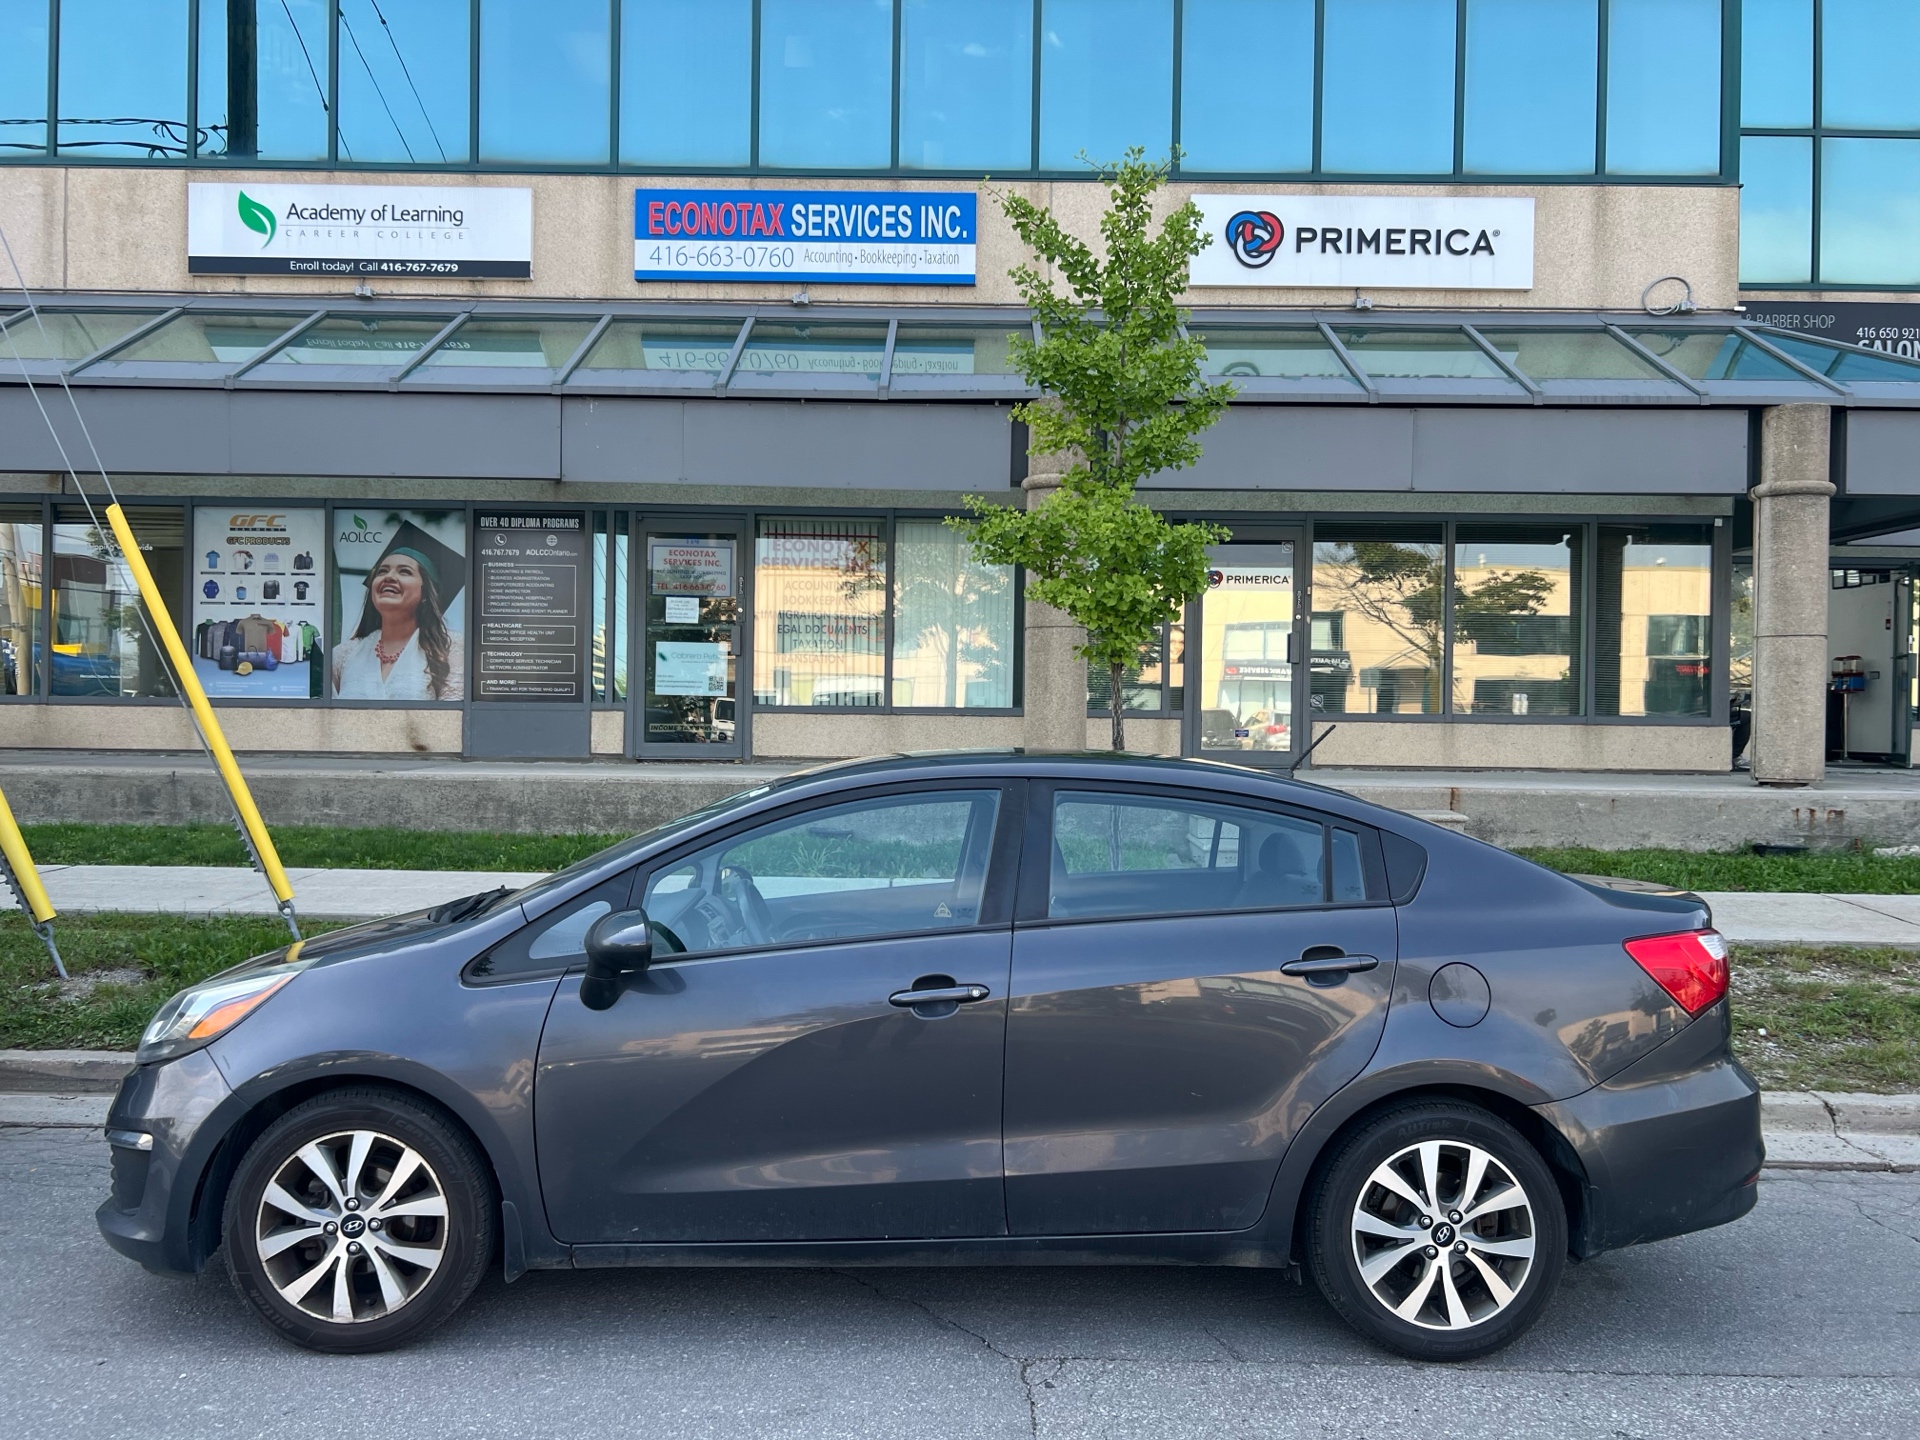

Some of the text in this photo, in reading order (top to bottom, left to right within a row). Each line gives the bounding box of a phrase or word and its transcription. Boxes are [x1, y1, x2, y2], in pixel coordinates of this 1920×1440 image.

[286, 202, 464, 227] Academy of Learning
[648, 201, 968, 238] ECONOTAX SERVICES INC.
[285, 229, 465, 240] CAREER COLLEGE
[650, 246, 960, 268] 416-663-0760 Accounting Bookkeeping Taxation
[290, 260, 459, 273] Enroll today! Call 416-767-7679
[1756, 314, 1801, 329] BARBER
[1803, 314, 1836, 329] SHOP
[1856, 327, 1876, 338] 416
[1879, 327, 1899, 339] 650
[229, 514, 287, 527] GFC
[480, 517, 580, 529] OVER 40 DIPLOMA PROGRAMS
[226, 536, 291, 546] GFC PRODUCTS
[339, 531, 382, 543] AOLCC
[481, 548, 520, 556] 416.767.7679
[772, 540, 869, 554] ECONOTAX
[668, 549, 717, 558] ECONOTAX
[663, 558, 722, 567] SERVICES INC.
[761, 556, 840, 571] SERVICES
[784, 580, 850, 591] ACCOUNTIN
[783, 596, 847, 606] BOOKKEEPIN
[775, 624, 868, 635] EGAL DOCUMENTS
[792, 639, 843, 649] TAXATION
[776, 654, 846, 664] TRANSLATION
